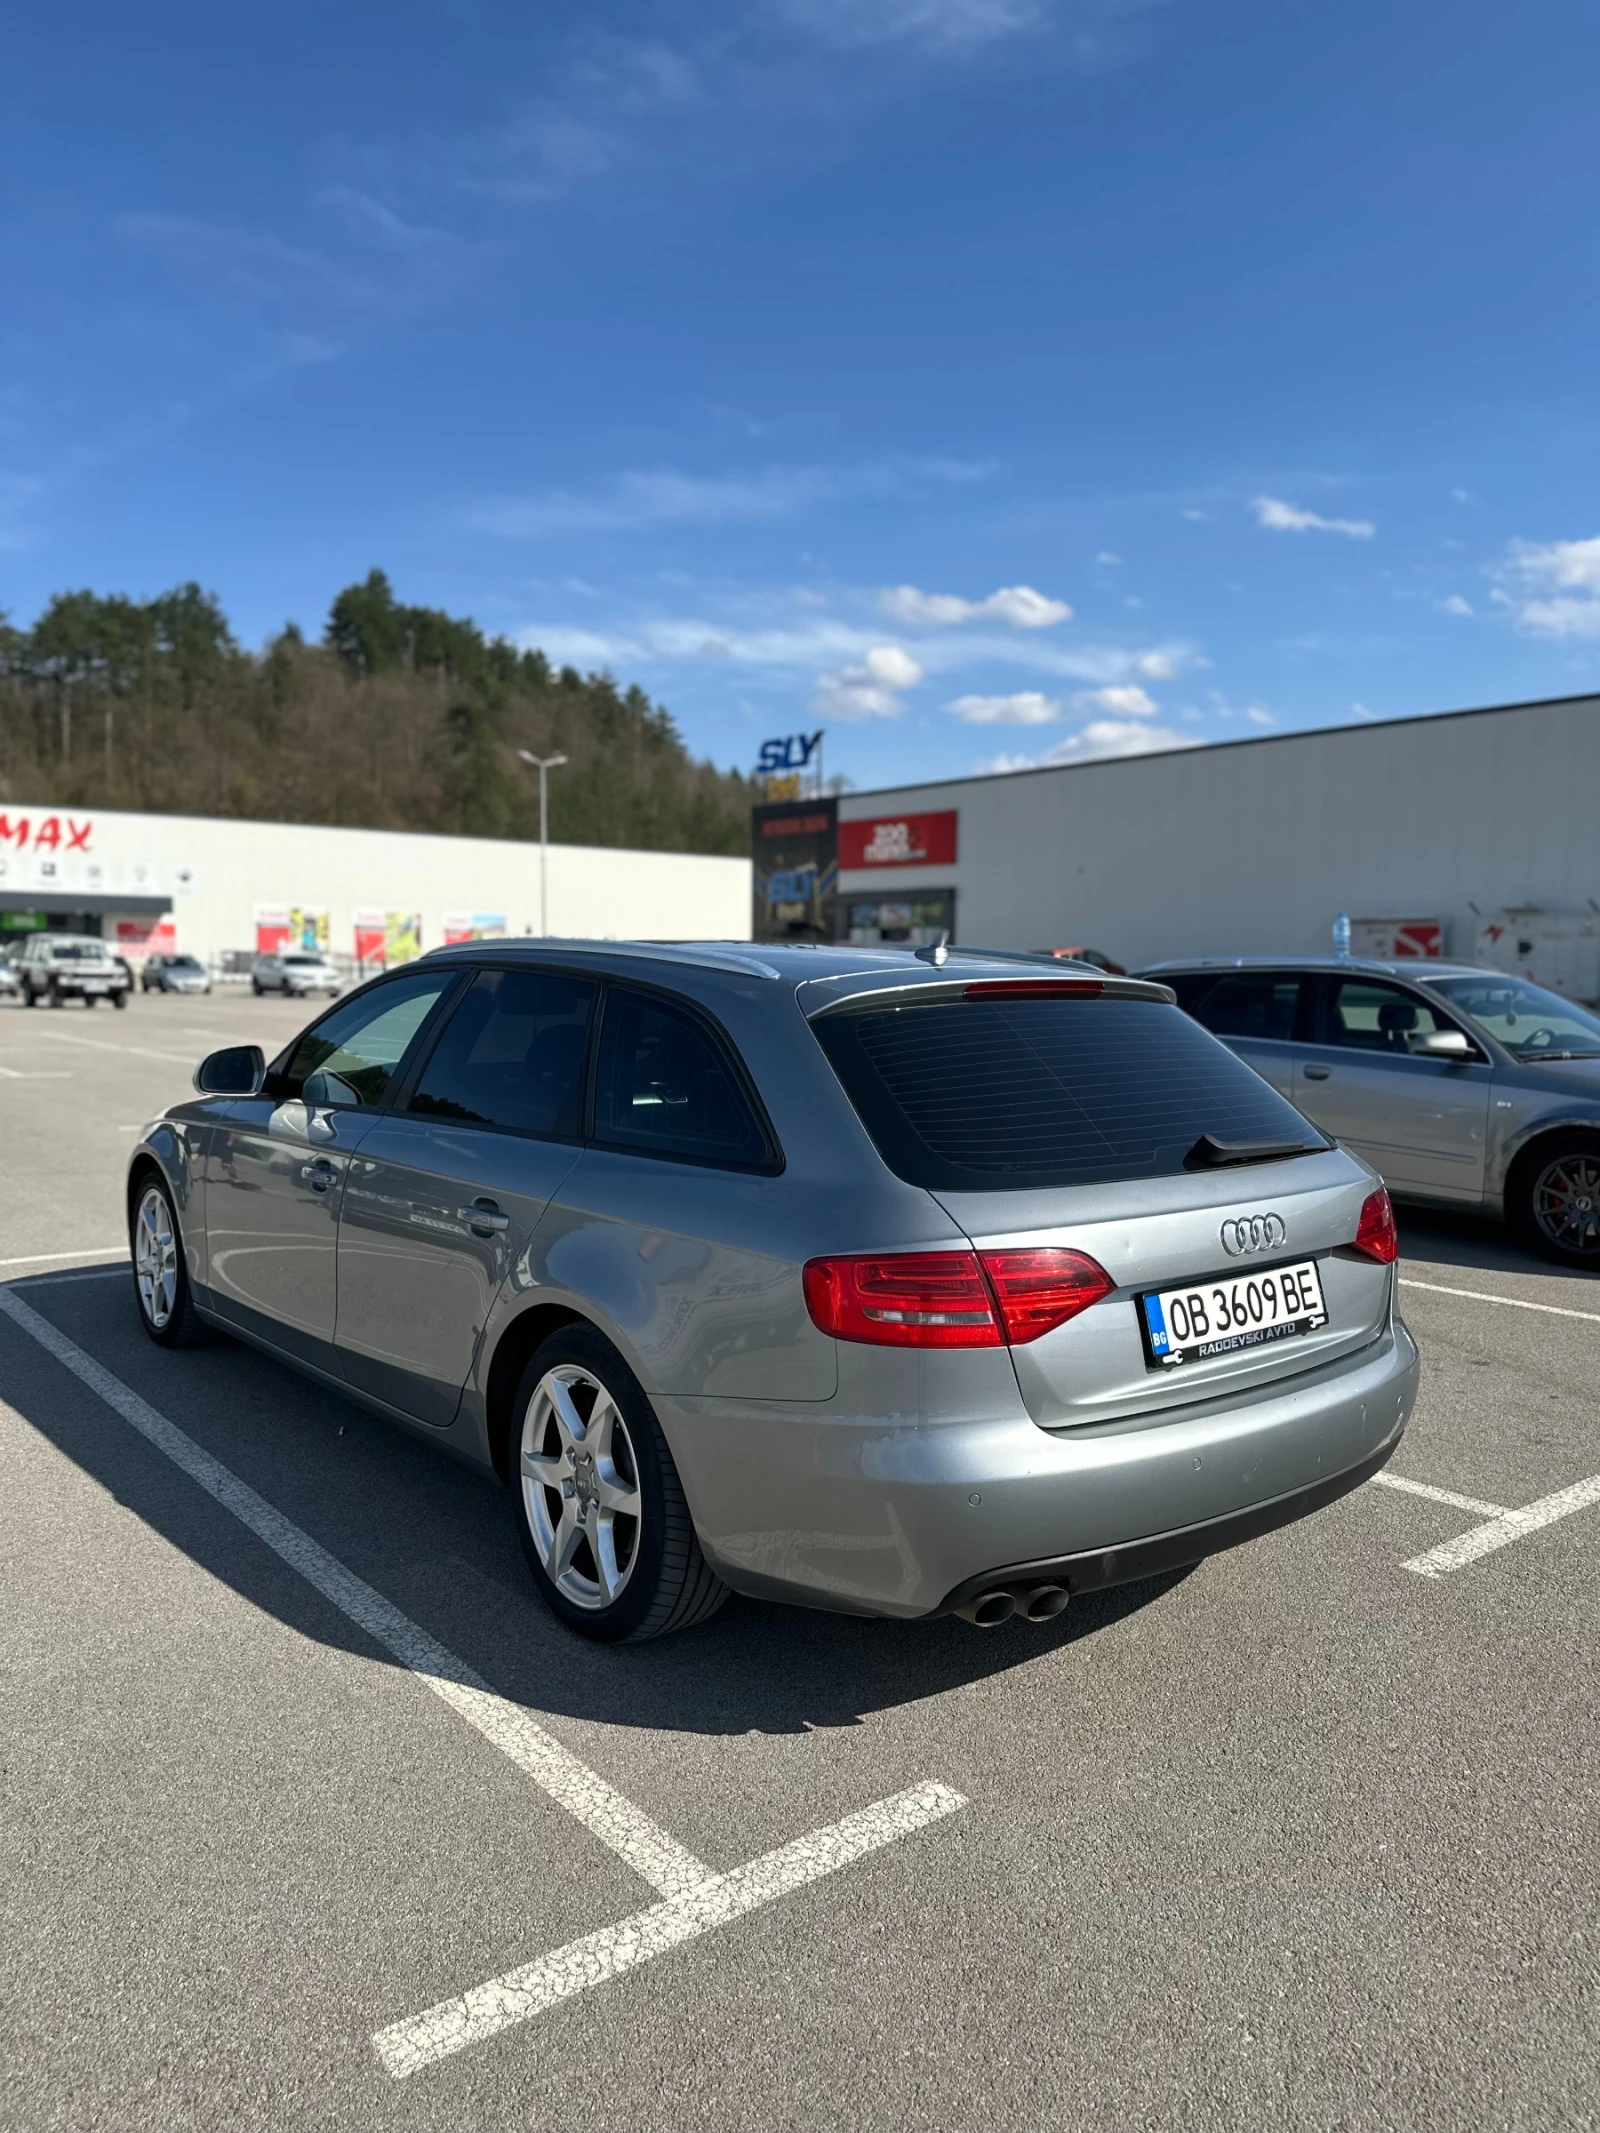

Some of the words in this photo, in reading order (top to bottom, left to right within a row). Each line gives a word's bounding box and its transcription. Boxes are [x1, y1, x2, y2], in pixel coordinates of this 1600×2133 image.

[757, 729, 825, 773] SLY
[1170, 1294, 1209, 1341] OB
[1213, 1278, 1277, 1331] 3609
[1280, 1269, 1317, 1315] BE
[1152, 1331, 1167, 1347] BG
